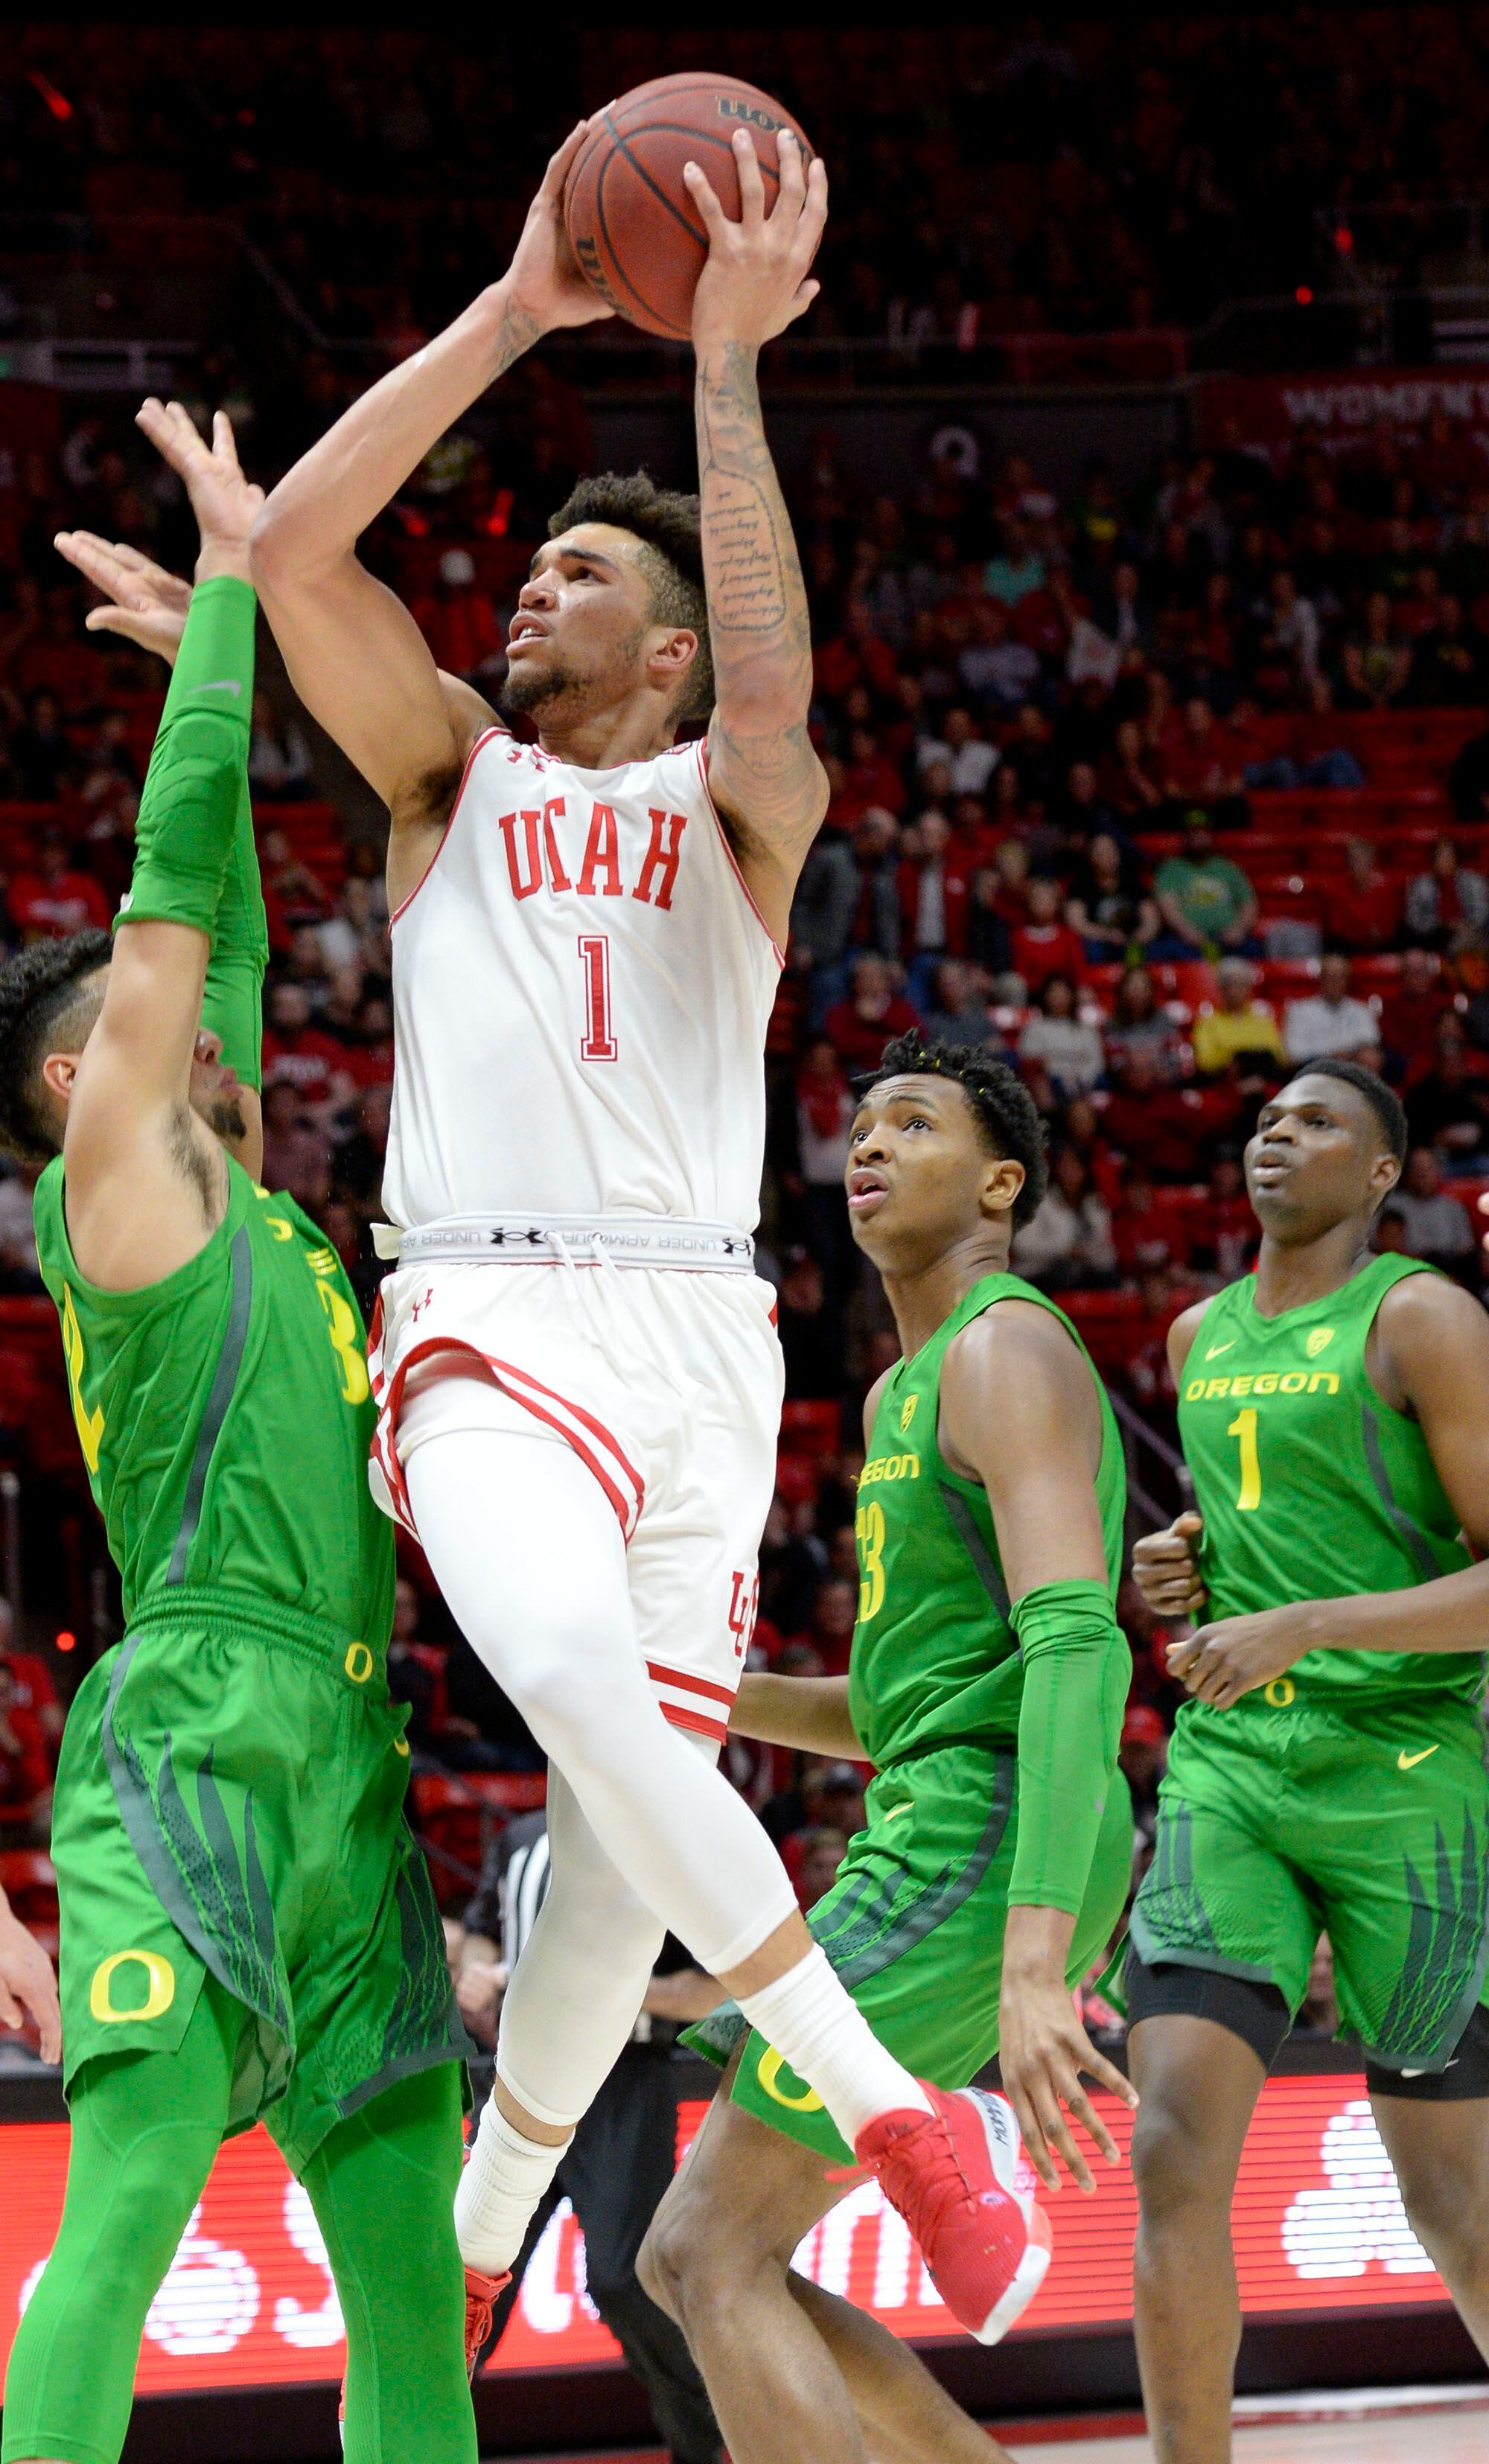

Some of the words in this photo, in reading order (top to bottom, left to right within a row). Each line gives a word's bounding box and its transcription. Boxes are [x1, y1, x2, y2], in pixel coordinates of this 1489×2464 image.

[498, 797, 687, 912] UTAH
[577, 935, 617, 1062] 1
[421, 1232, 481, 1246] UNDER
[658, 1237, 717, 1252] UNDER
[1186, 1372, 1339, 1401] OREGON
[1228, 1408, 1262, 1511] 1
